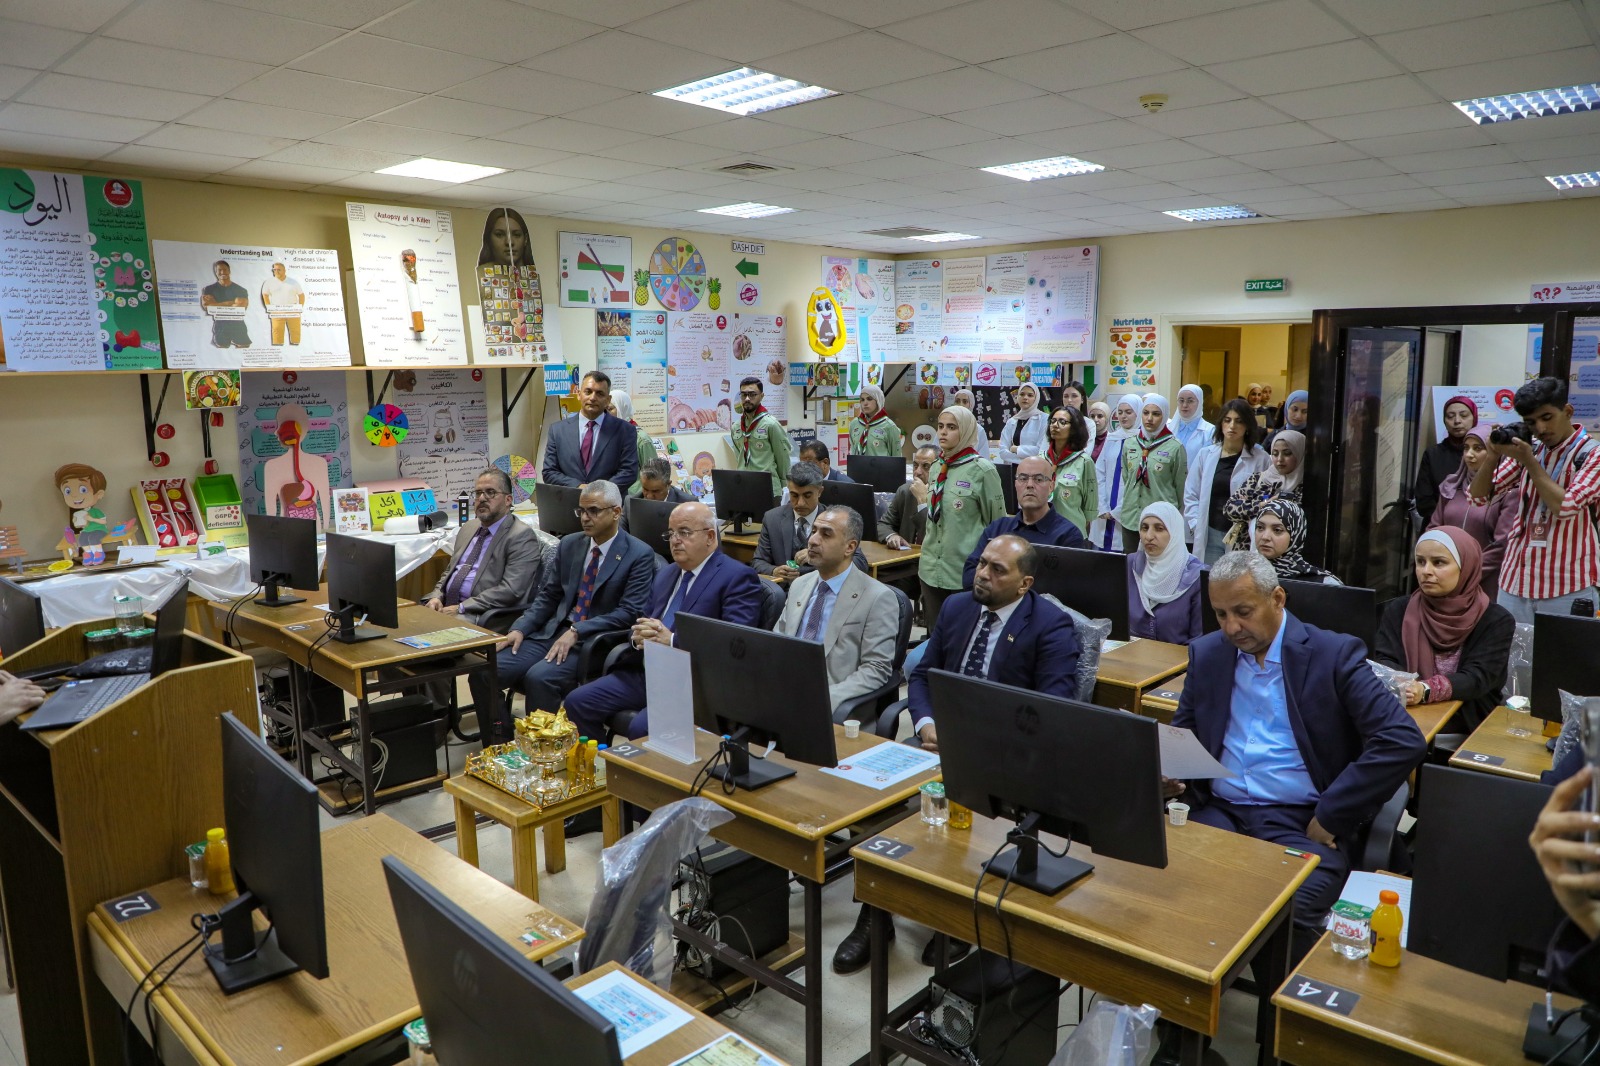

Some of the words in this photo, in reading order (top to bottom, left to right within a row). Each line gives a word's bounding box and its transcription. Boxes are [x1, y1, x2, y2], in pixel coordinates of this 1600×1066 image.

[8, 173, 71, 226] اليود
[732, 242, 750, 252] DASH
[750, 244, 765, 254] DIET
[89, 253, 95, 261] 2
[220, 248, 260, 259] Understanding
[261, 250, 273, 258] BMI
[1246, 281, 1265, 290] EXIT
[1566, 284, 1595, 292] الهاشمية
[95, 291, 100, 299] 3
[98, 312, 103, 320] 4
[1113, 317, 1153, 327] Nutrients
[544, 369, 570, 380] NUTRITION
[430, 381, 453, 391] الكافيين
[545, 380, 571, 392] EDUCATION
[387, 410, 395, 419] 1
[373, 429, 383, 437] 5
[384, 431, 391, 441] 4
[391, 427, 401, 436] 3
[379, 495, 396, 508] أكل
[408, 490, 428, 504] أكل
[207, 520, 241, 528] deficiency
[612, 745, 639, 756] 16
[1472, 754, 1489, 762] 8
[868, 840, 902, 855] 15
[115, 895, 152, 917] 22
[1297, 981, 1339, 1007] 14
